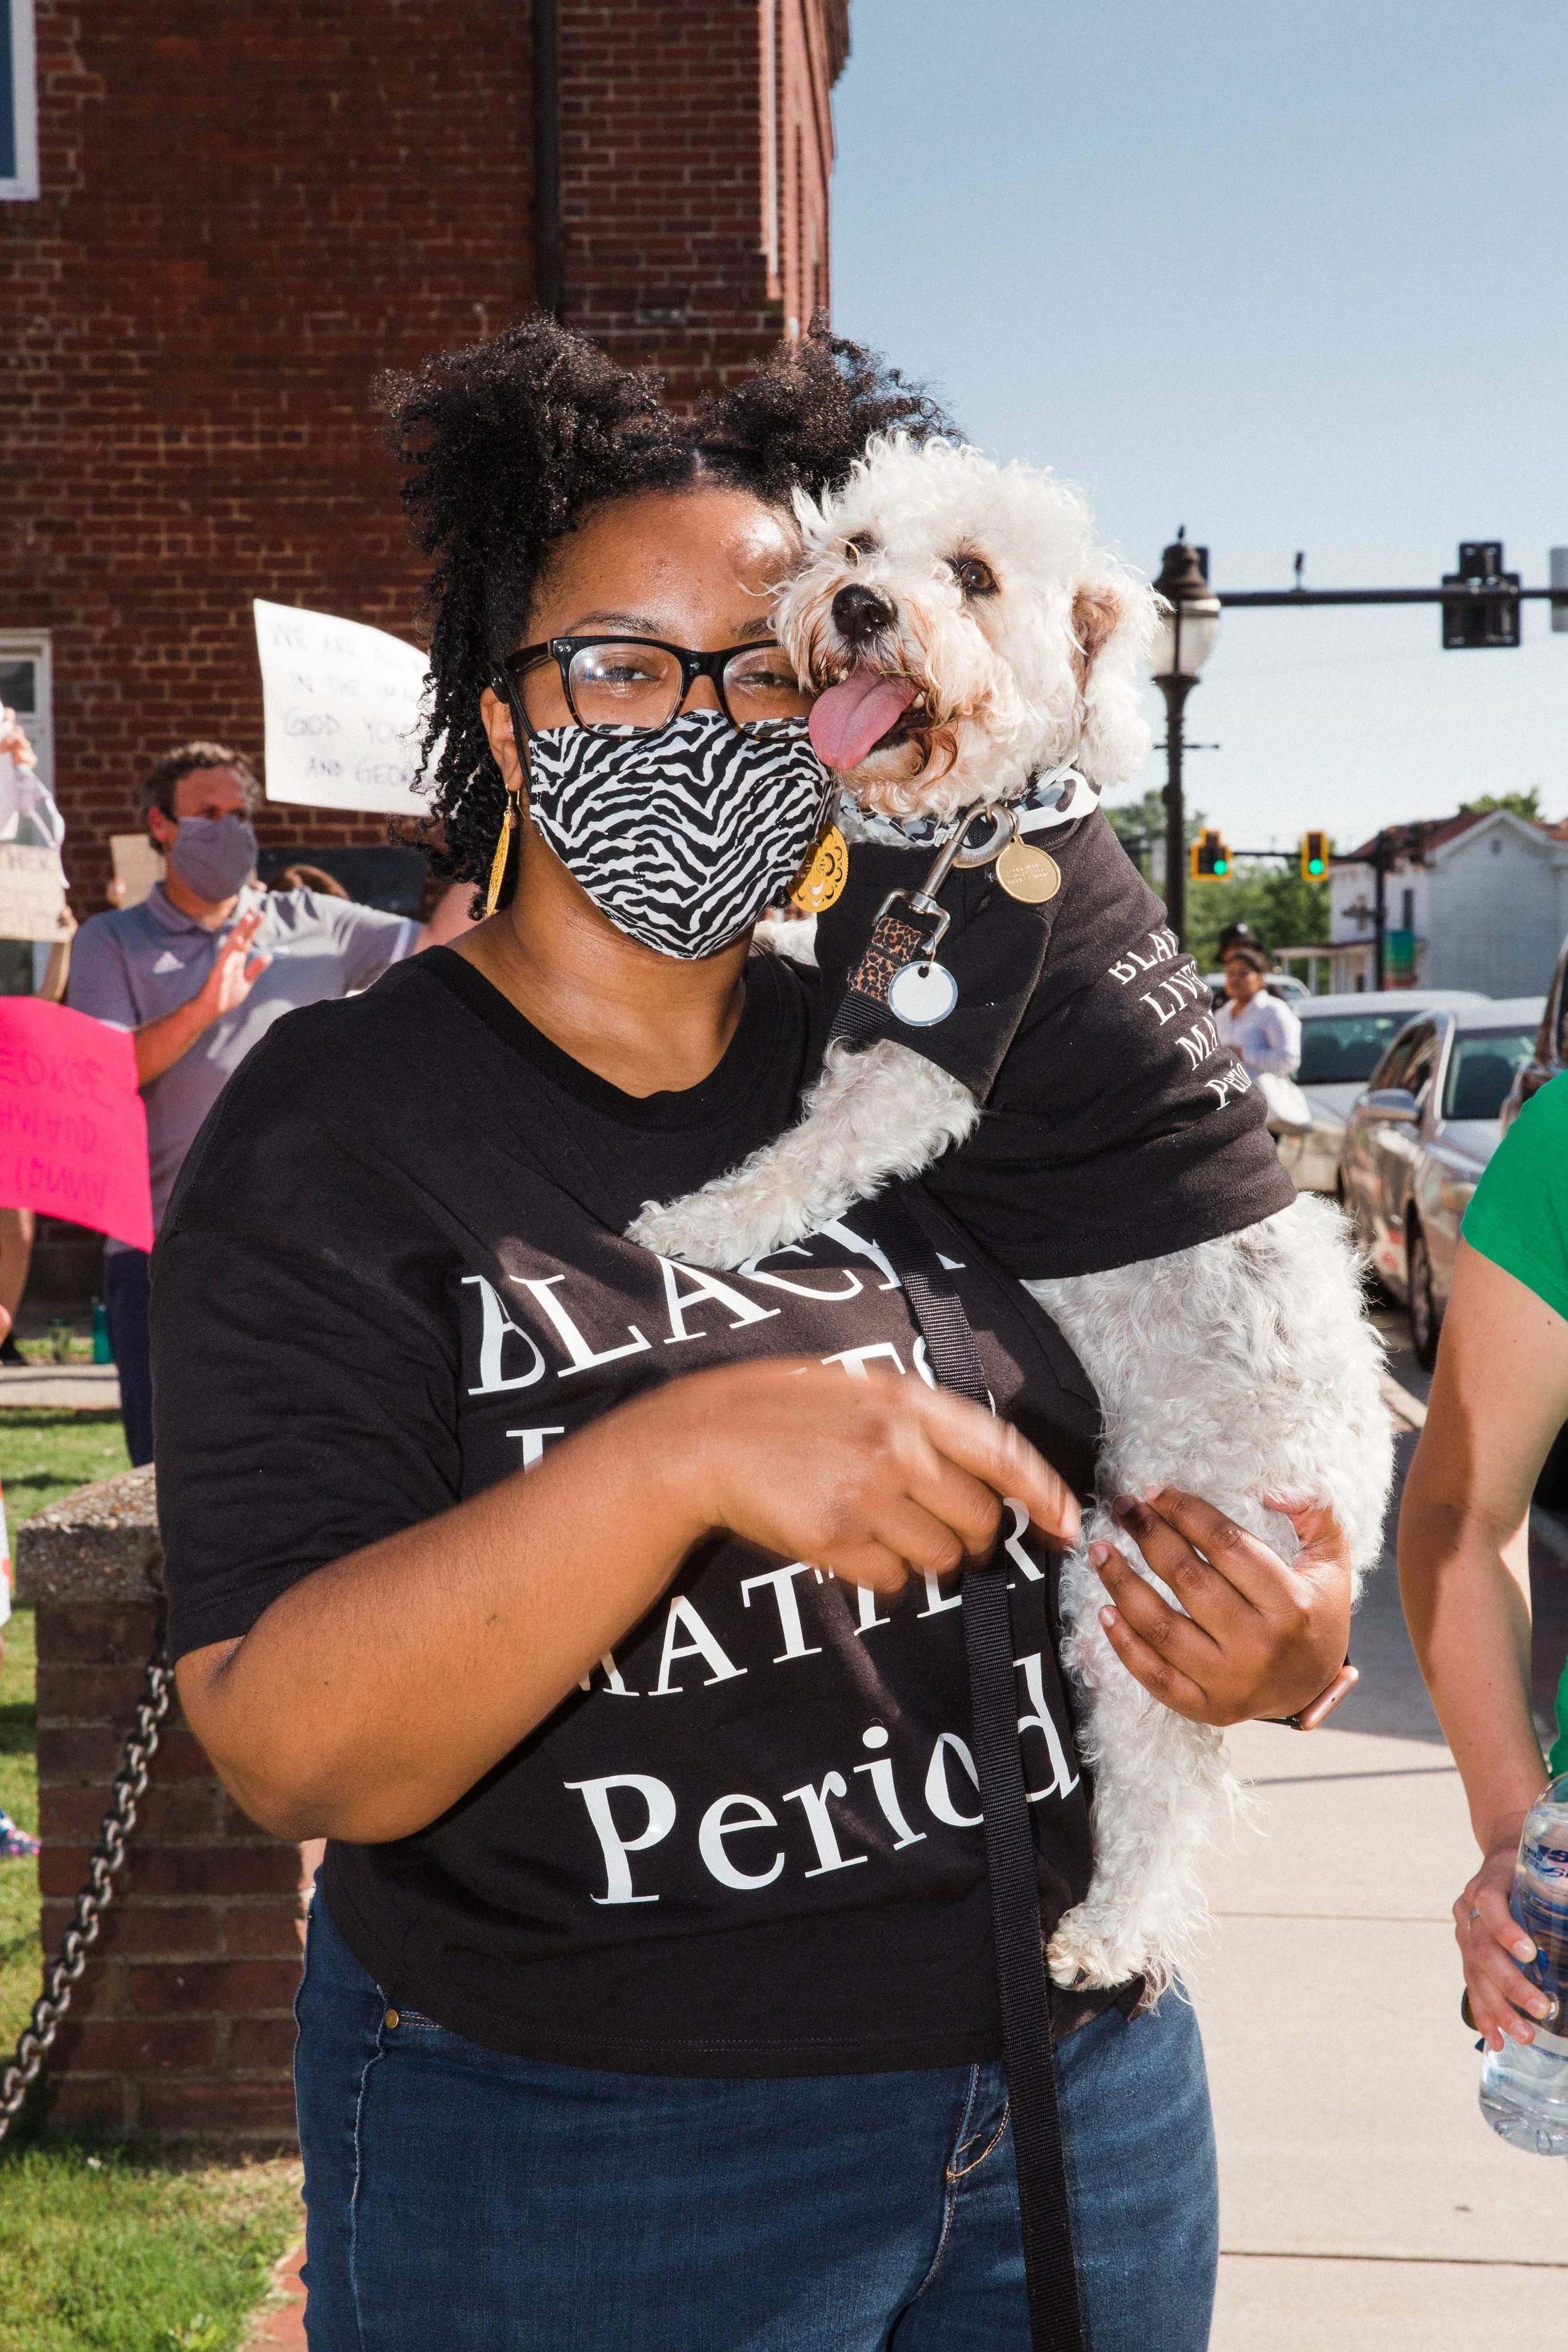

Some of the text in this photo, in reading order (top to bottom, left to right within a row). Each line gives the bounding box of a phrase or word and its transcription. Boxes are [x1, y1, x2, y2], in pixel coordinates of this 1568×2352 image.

[283, 706, 341, 736] GOD
[305, 756, 345, 778] AND
[1175, 1009, 1218, 1071] MA
[564, 1652, 1081, 1905] Period
